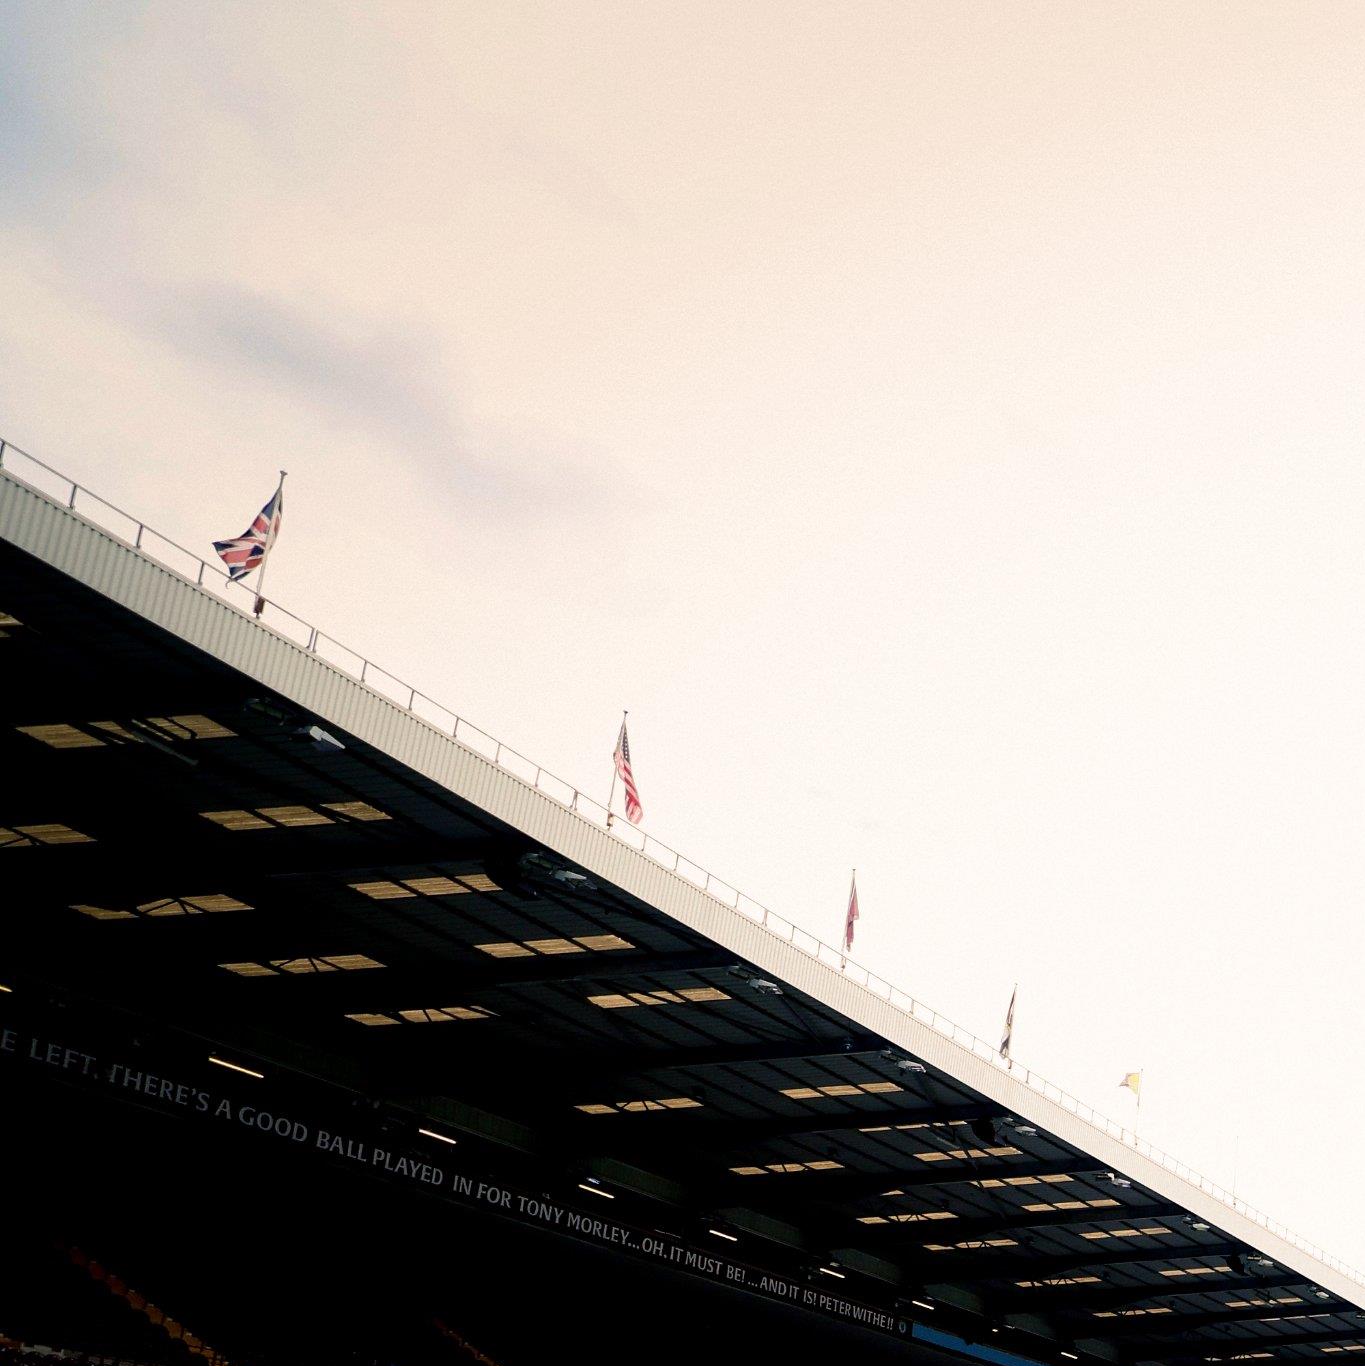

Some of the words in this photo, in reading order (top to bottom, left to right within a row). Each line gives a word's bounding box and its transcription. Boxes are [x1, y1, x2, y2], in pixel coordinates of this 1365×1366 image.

[109, 1063, 210, 1112] THERE'S
[214, 1099, 232, 1120] A
[239, 1106, 307, 1142] GOOD
[316, 1129, 367, 1162] BALL
[371, 1148, 443, 1186] PLAYED
[452, 1175, 473, 1196] IN
[476, 1182, 512, 1209] FOR
[517, 1195, 564, 1225] TONY
[669, 1245, 684, 1263] IT
[685, 1250, 723, 1276] MUST
[726, 1265, 746, 1284] BE!
[788, 1284, 801, 1301] IT
[803, 1289, 817, 1306] IS!
[819, 1295, 852, 1317] PETER
